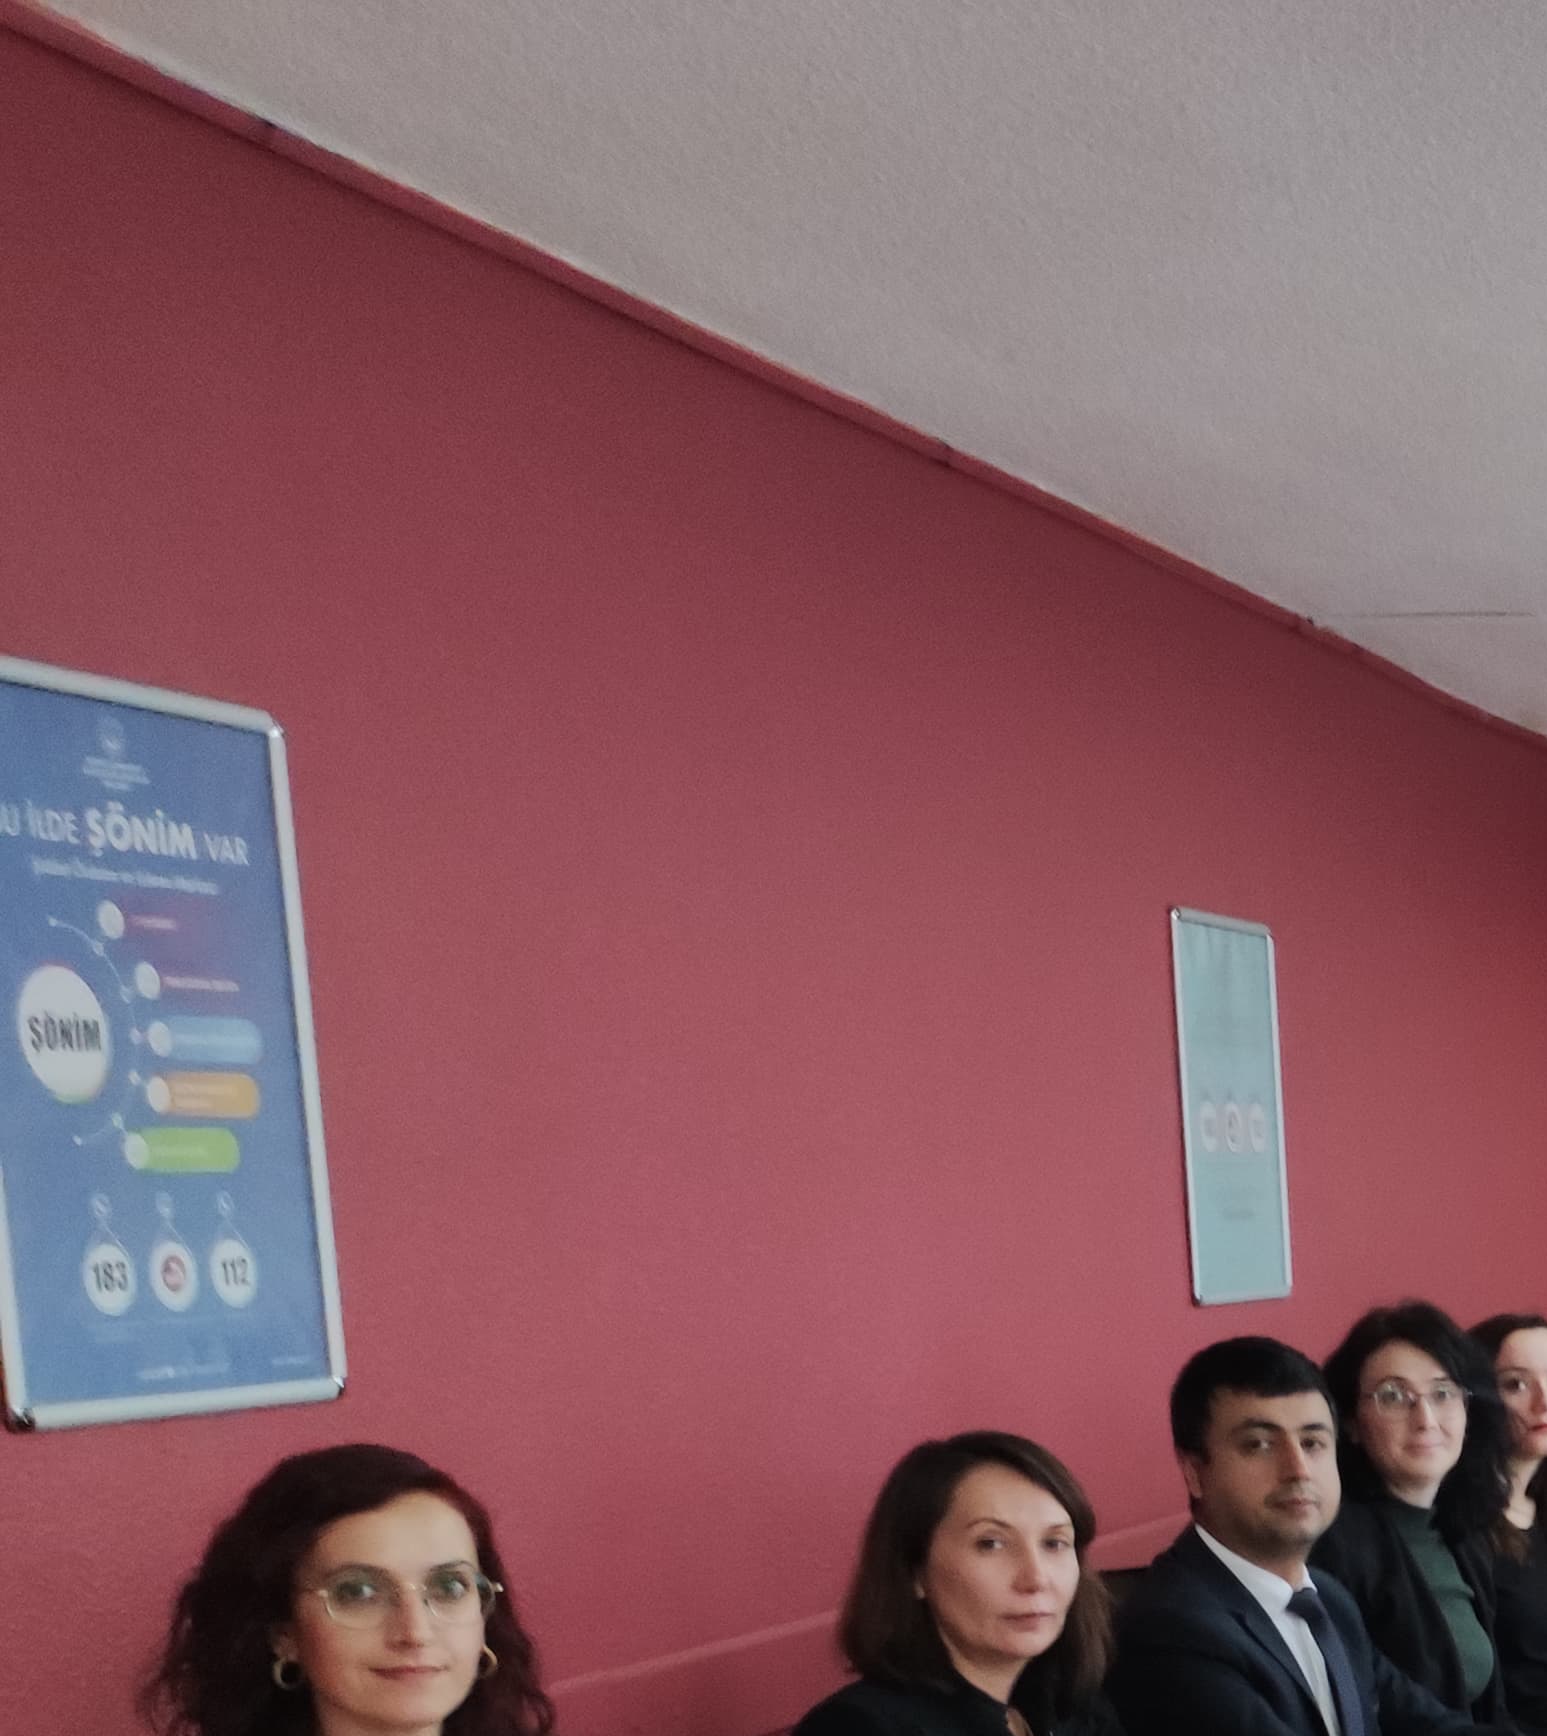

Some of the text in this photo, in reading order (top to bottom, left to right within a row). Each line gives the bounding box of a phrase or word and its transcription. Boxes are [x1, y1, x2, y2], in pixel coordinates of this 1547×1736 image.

[86, 801, 198, 860] ŞÖNİM
[203, 831, 250, 866] VAR
[93, 1260, 130, 1293] 183
[221, 1257, 251, 1287] 112
